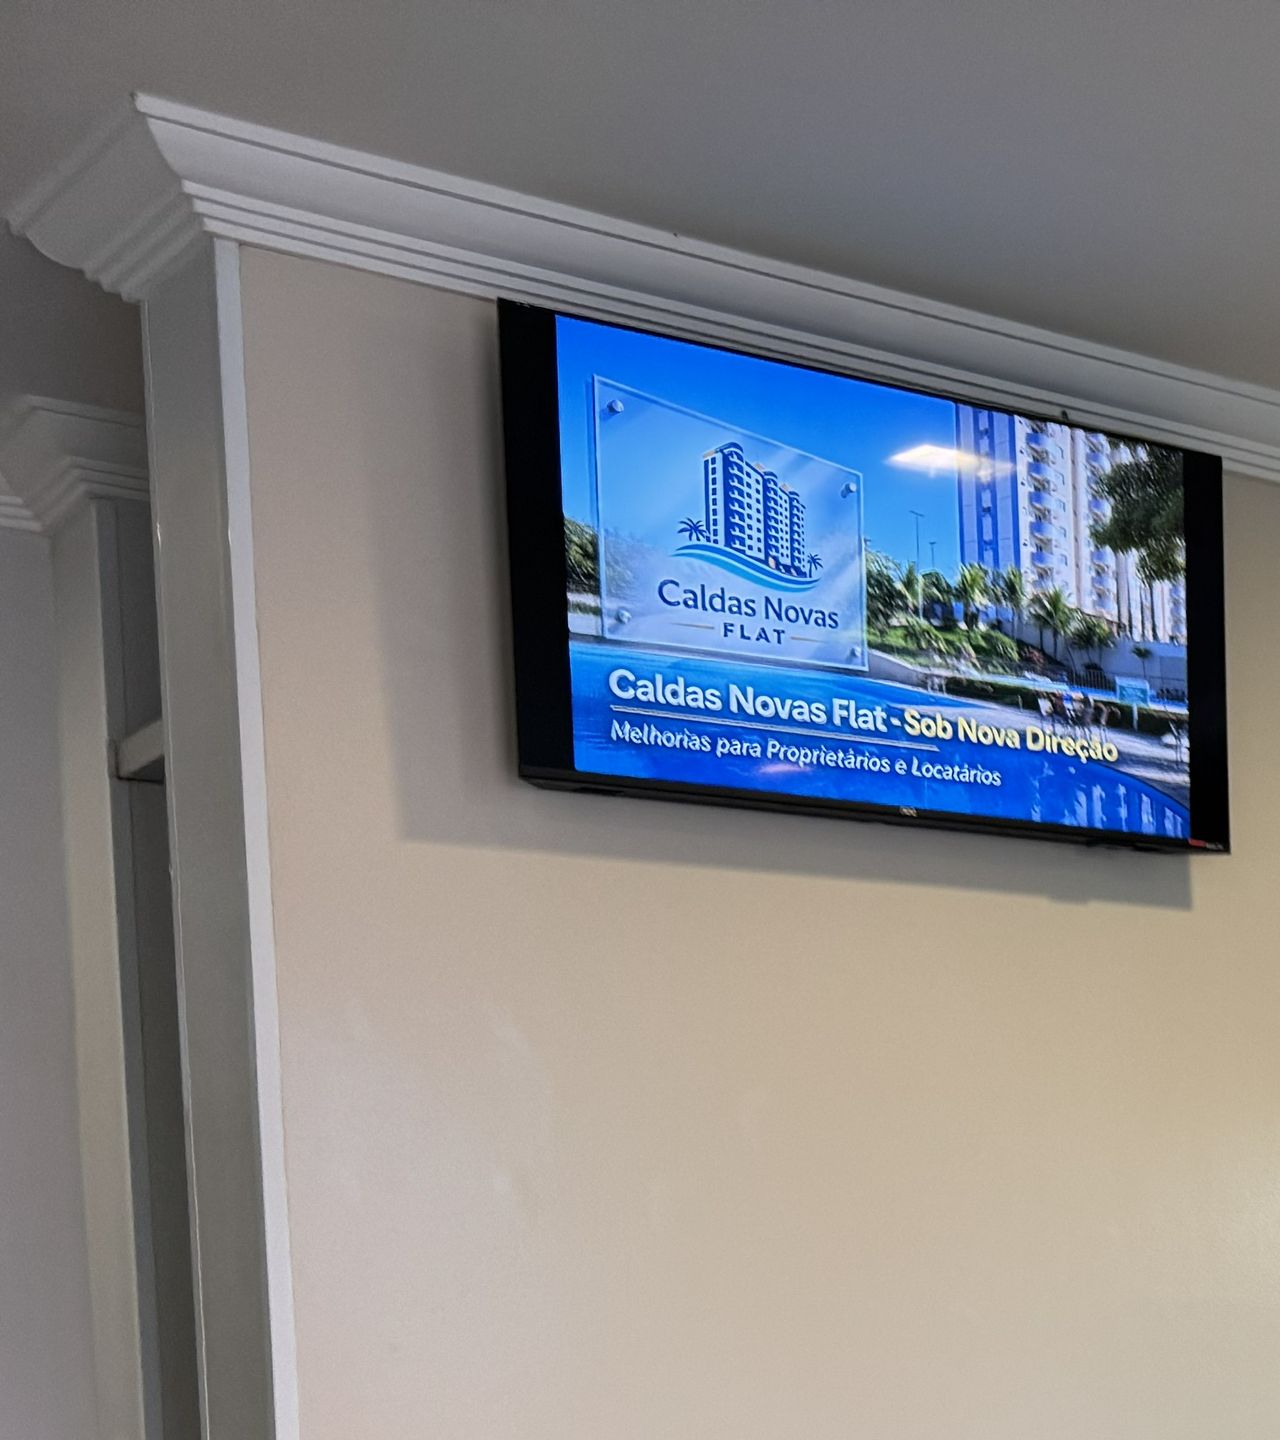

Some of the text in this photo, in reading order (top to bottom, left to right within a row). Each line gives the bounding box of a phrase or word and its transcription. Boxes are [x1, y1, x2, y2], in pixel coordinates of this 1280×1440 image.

[658, 578, 839, 629] Caldas Novas
[723, 622, 786, 644] FLAT
[608, 667, 723, 711] Caldas
[729, 683, 828, 725] Novas
[832, 697, 888, 733] Flat
[903, 708, 953, 740] Sob
[958, 716, 1021, 749] Nova
[1026, 726, 1119, 764] Direção
[610, 719, 1002, 787] Melhorias para Proprietários e Locatários
